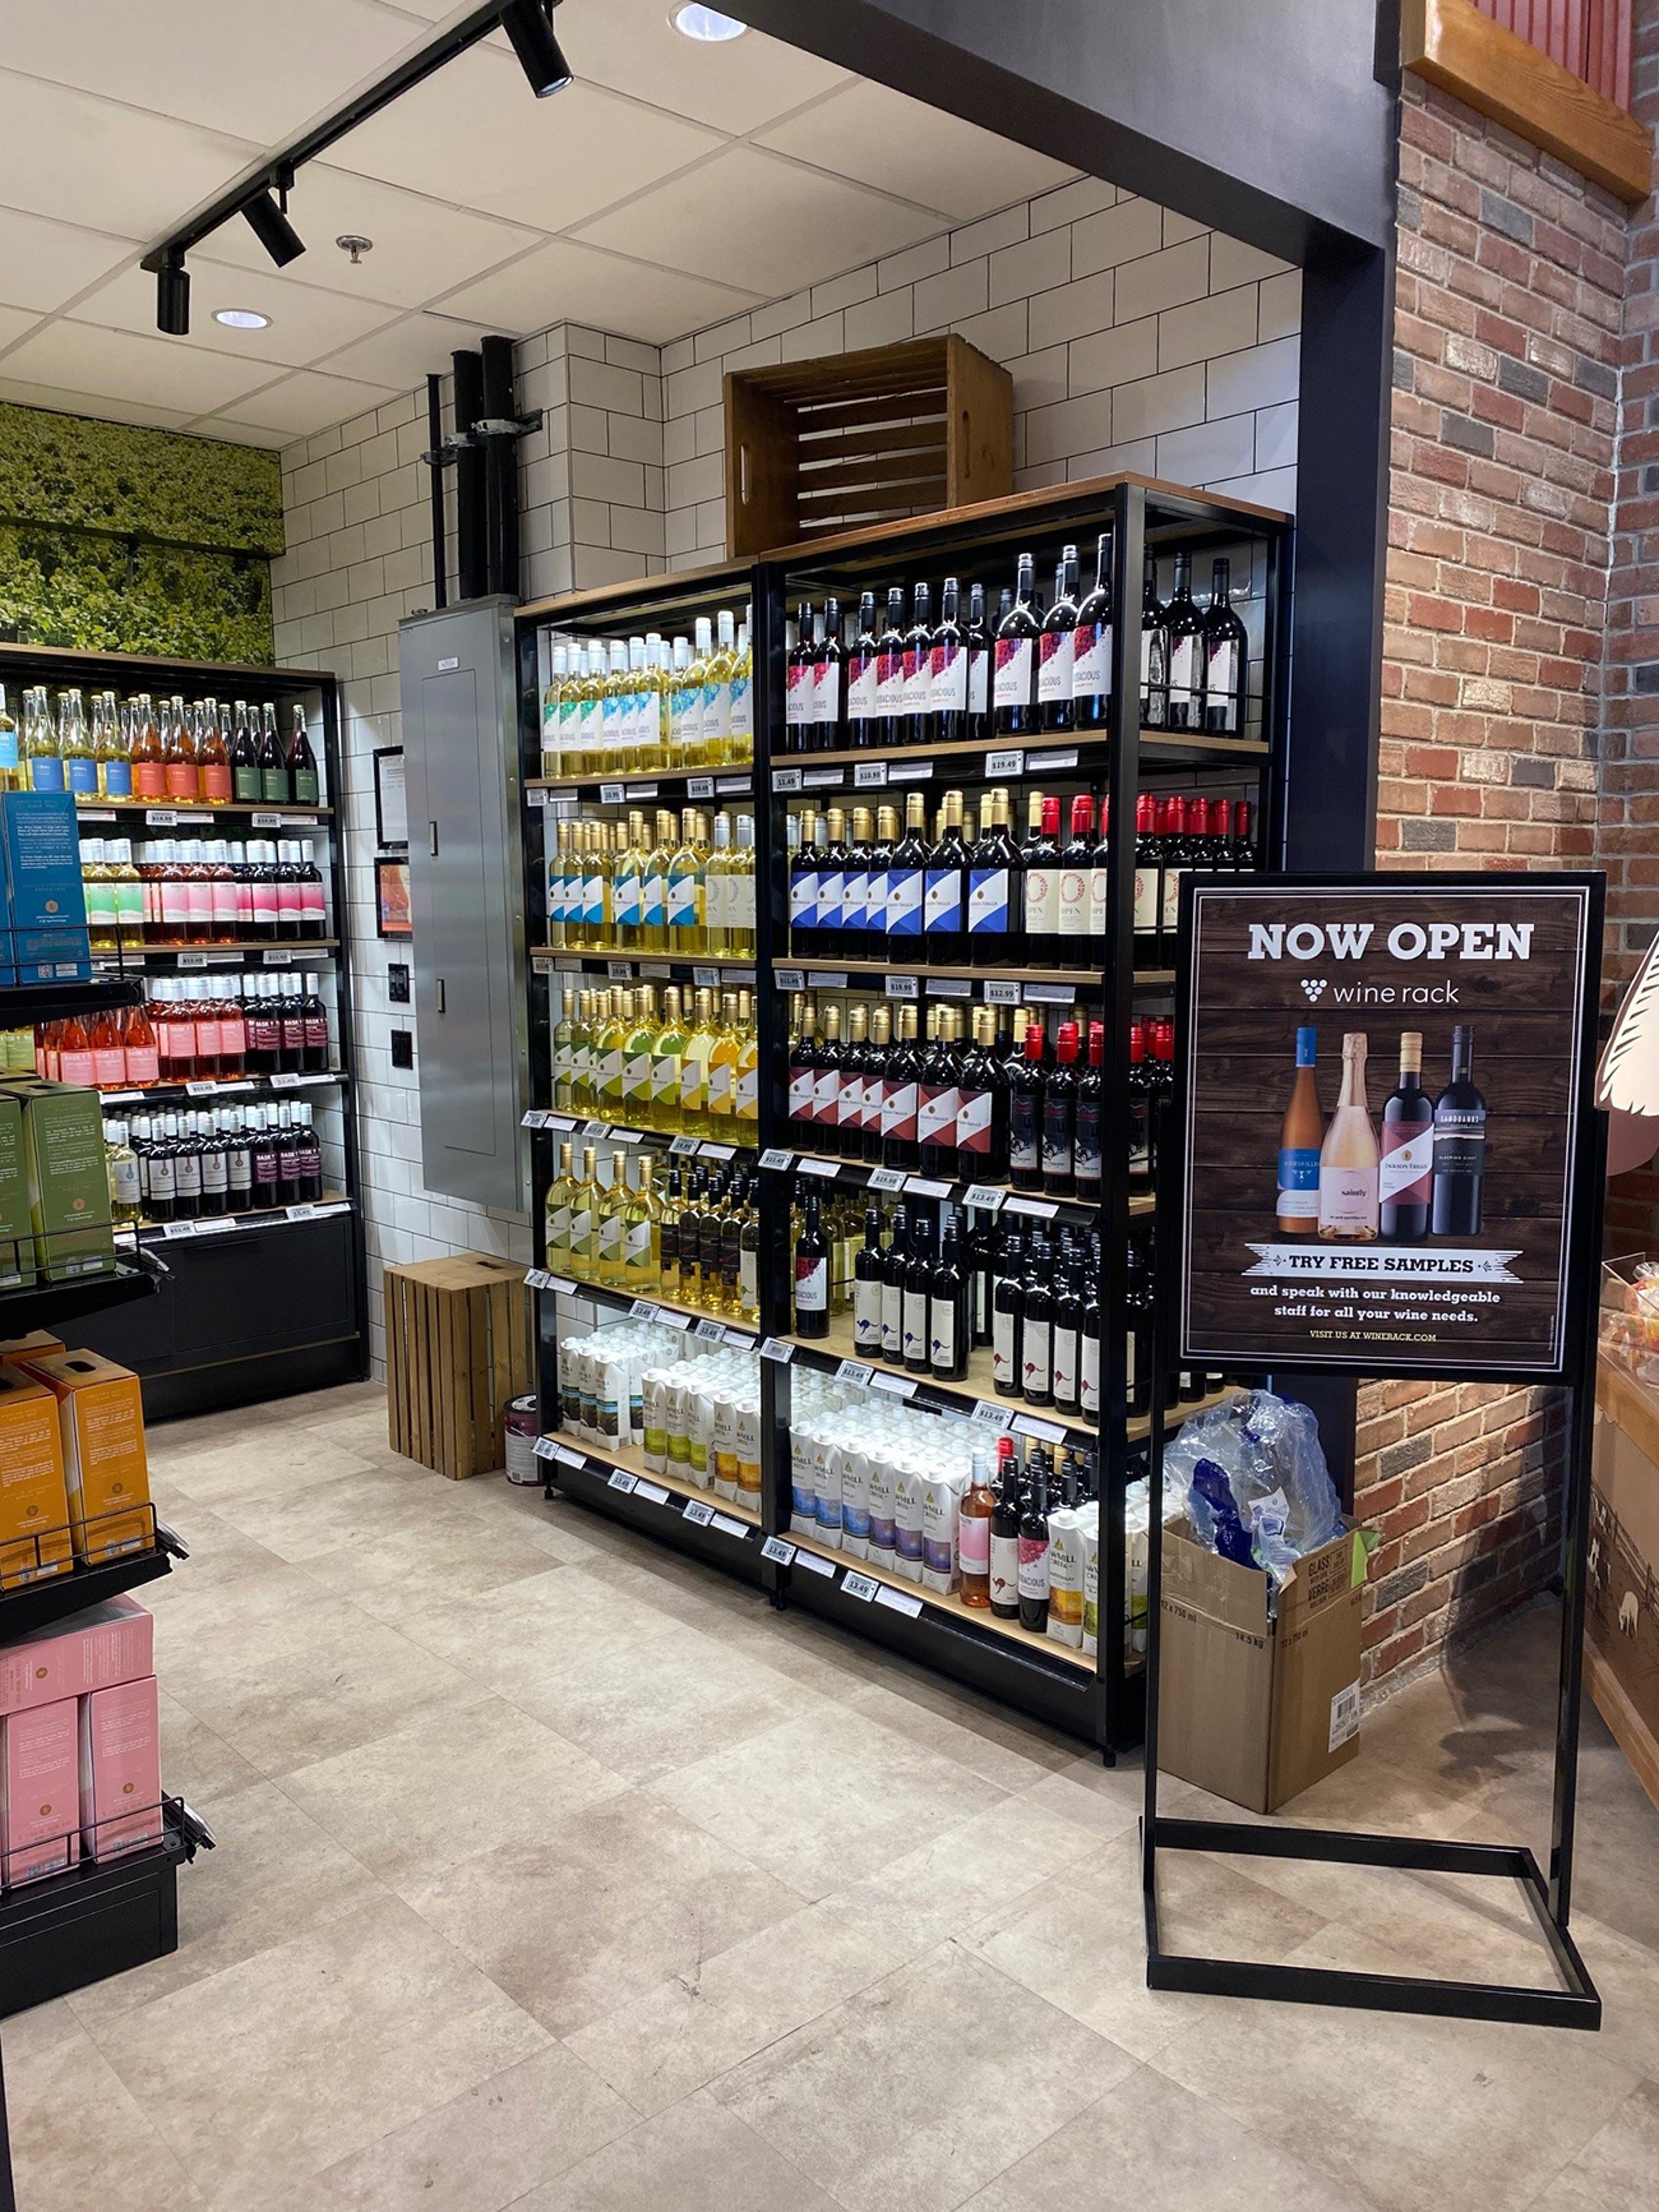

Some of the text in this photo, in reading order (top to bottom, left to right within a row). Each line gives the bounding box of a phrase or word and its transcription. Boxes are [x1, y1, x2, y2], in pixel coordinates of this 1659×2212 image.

[992, 761, 1016, 769] $19.49
[1247, 923, 1535, 960] NOW OPEN
[990, 989, 1014, 998] $12.99
[1334, 980, 1459, 1003] wine rack
[1341, 1189, 1367, 1197] saintly
[1289, 1255, 1473, 1273] TRY FREE SAMPLES
[1251, 1285, 1501, 1304] and speak with our knowledgeable
[1274, 1305, 1478, 1322] staff for all your wine needs.
[1310, 1330, 1437, 1341] VISIT US AT WINERACK.COM
[979, 1410, 1004, 1421] $13.49
[1308, 1555, 1329, 1577] GLASS
[1235, 1631, 1265, 1650] 14.5 kg
